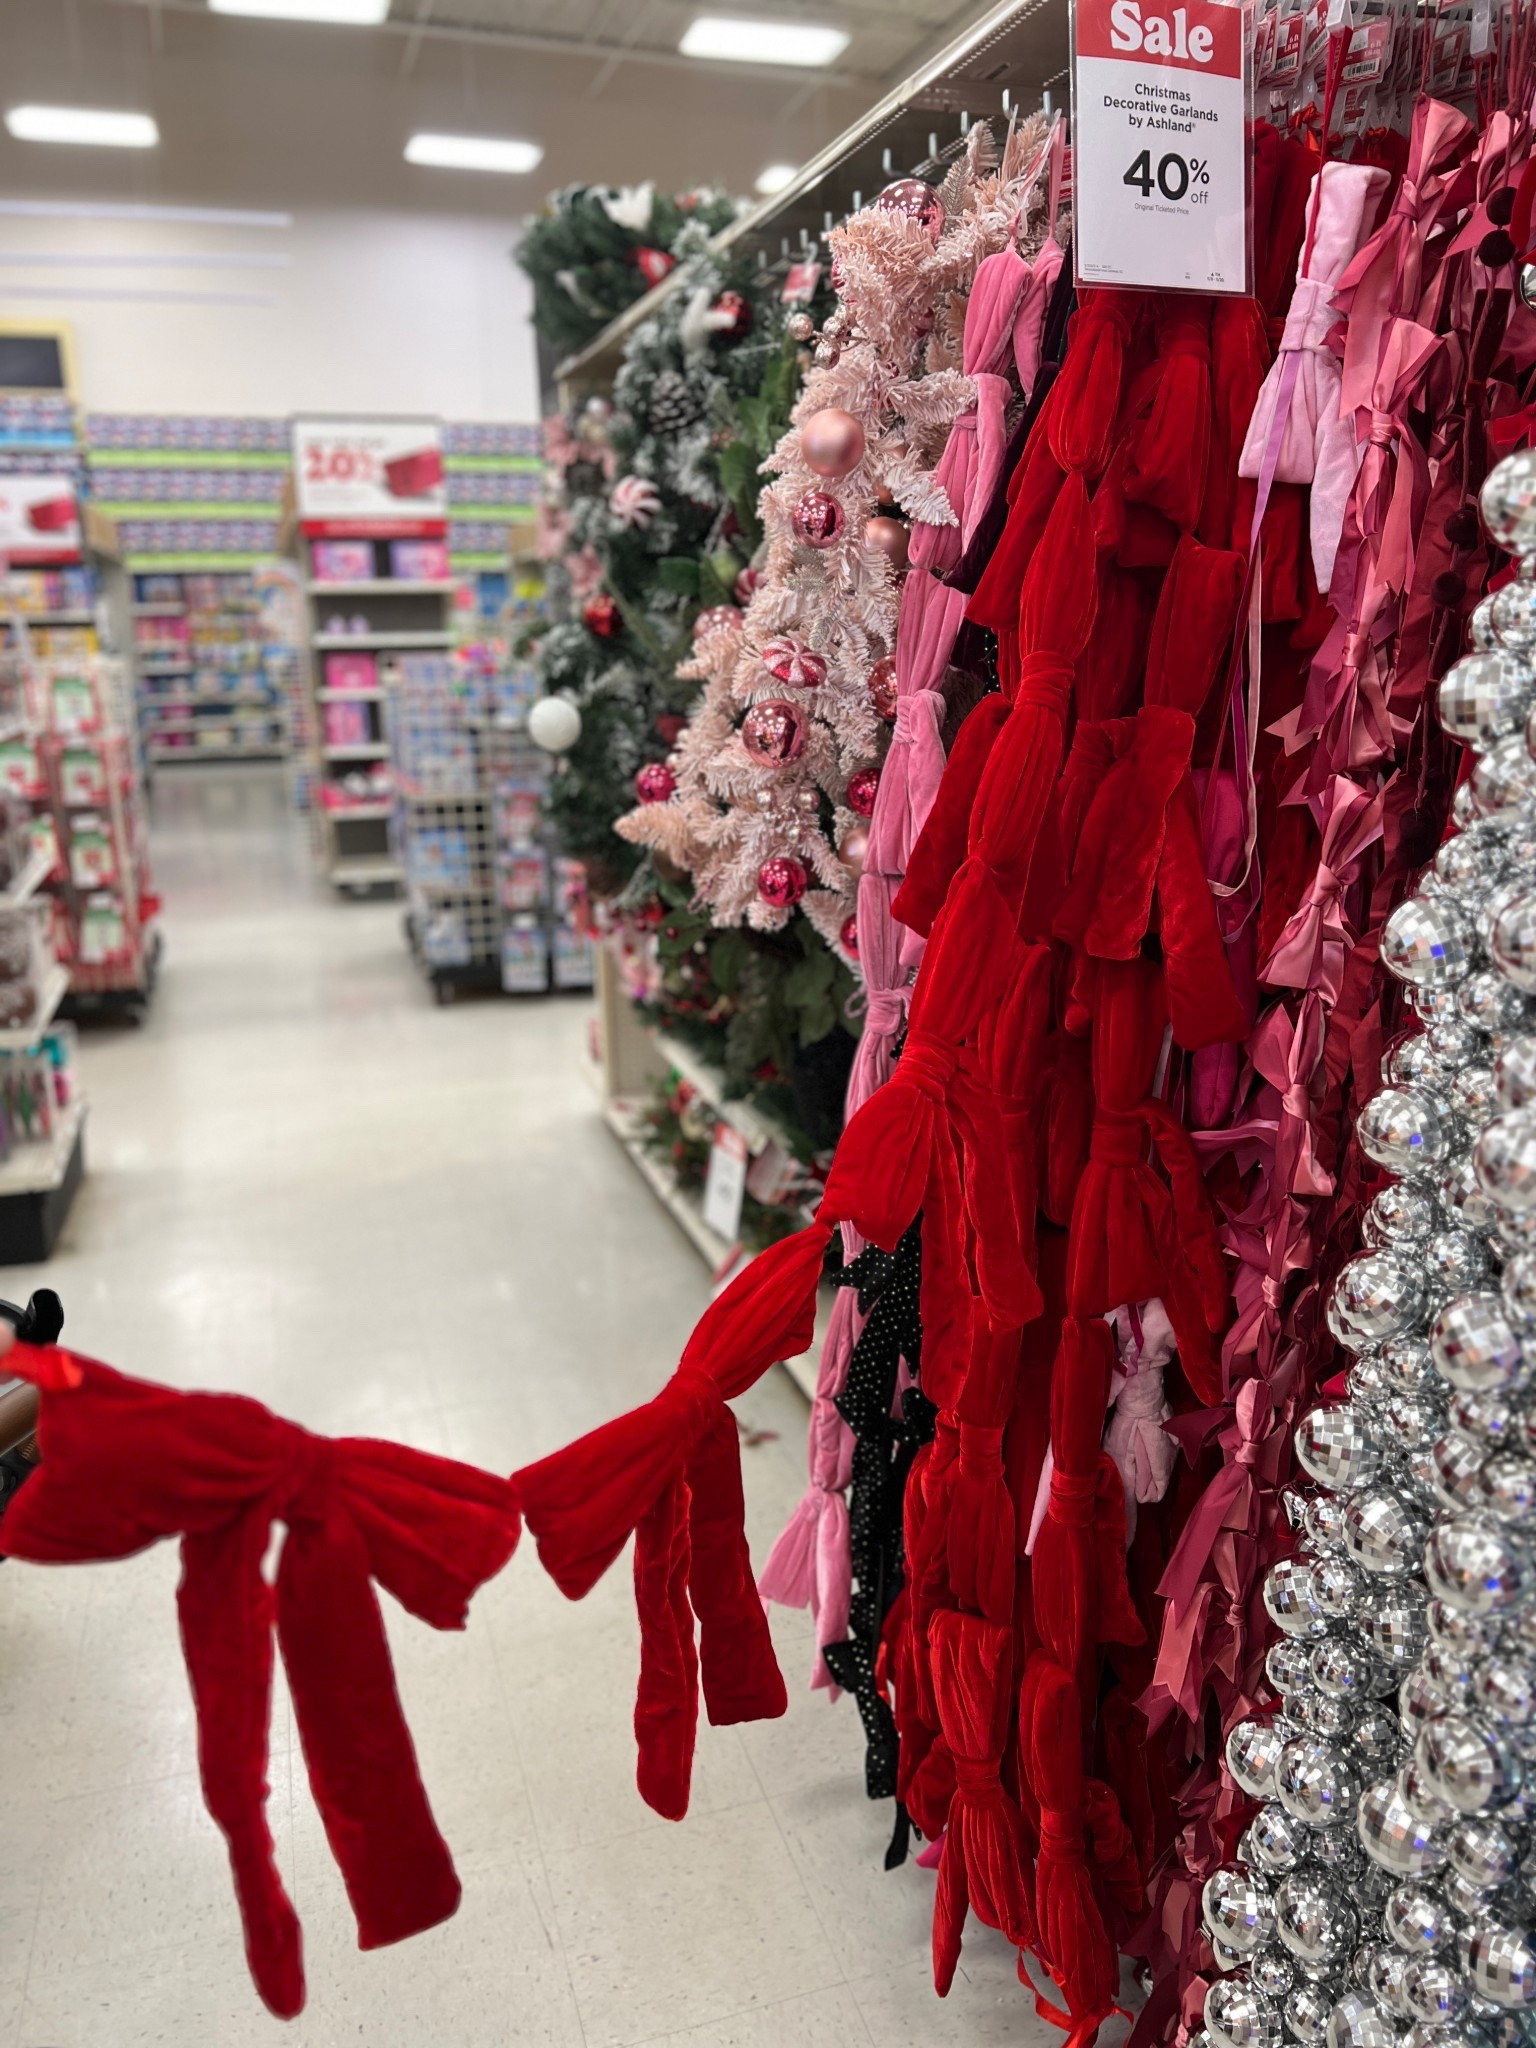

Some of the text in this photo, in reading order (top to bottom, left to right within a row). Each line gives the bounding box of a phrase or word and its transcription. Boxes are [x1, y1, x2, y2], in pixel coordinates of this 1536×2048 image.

[1110, 0, 1214, 63] Sale
[1134, 83, 1191, 102] Christmas
[1103, 95, 1219, 122] Decorative Garlands
[1128, 113, 1143, 128] by
[1123, 149, 1210, 201] 40%
[1190, 190, 1209, 204] off
[1134, 202, 1190, 215] Original Ticketed Price
